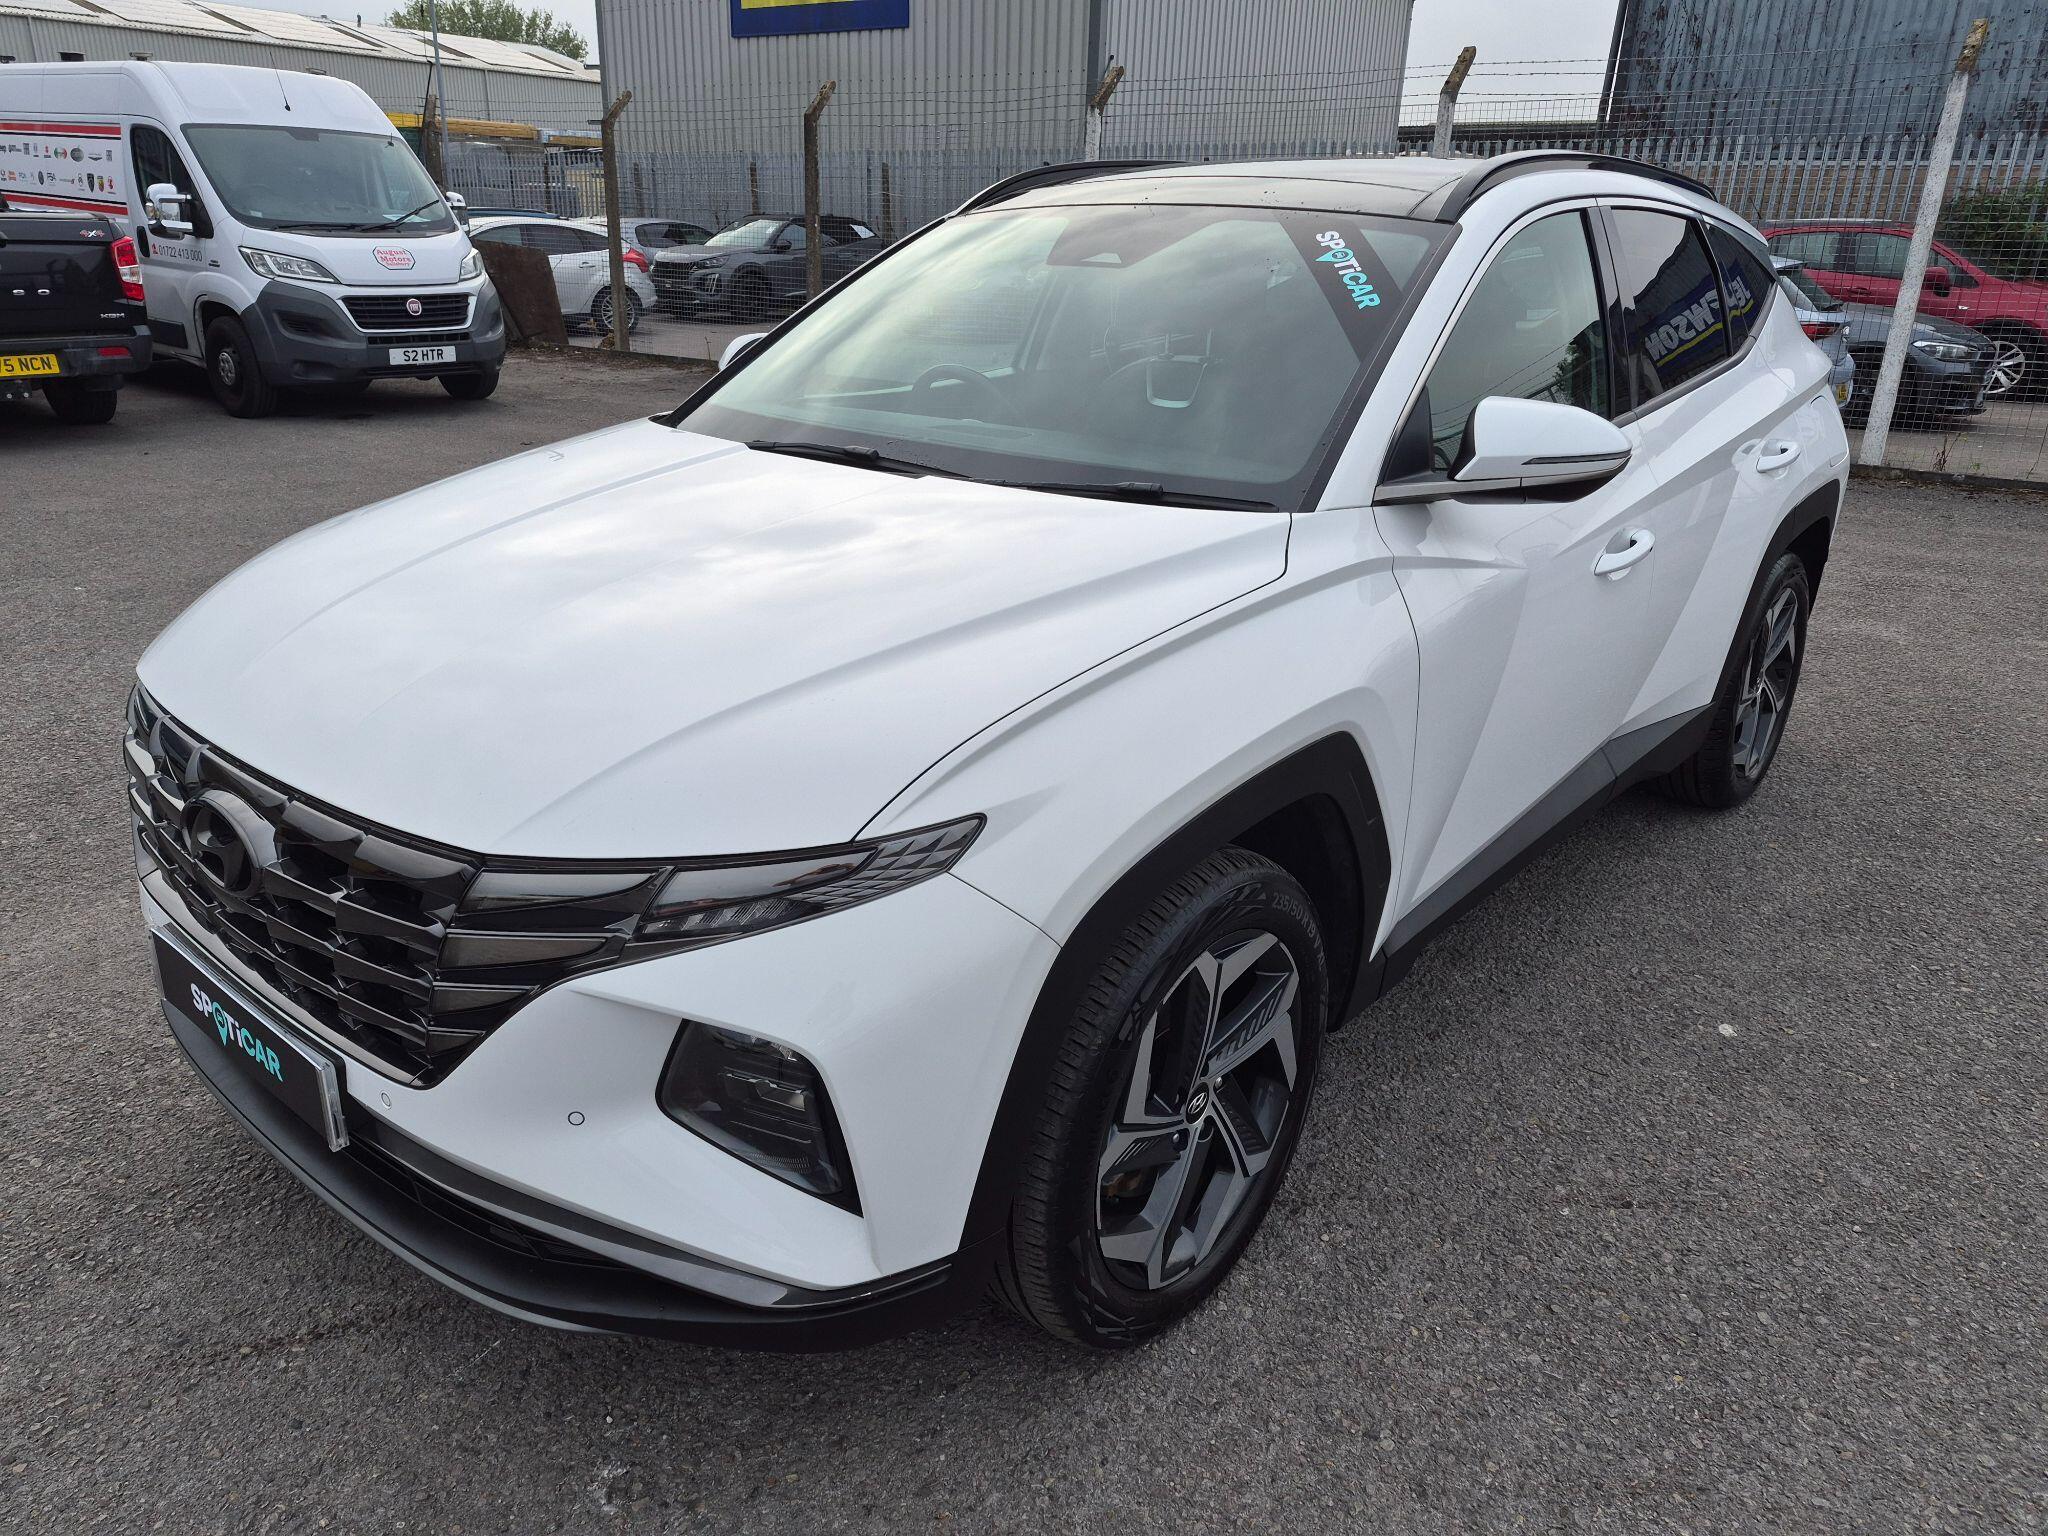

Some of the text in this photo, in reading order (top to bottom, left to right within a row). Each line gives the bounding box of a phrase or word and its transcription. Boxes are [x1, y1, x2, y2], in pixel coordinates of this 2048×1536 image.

[159, 245, 203, 262] 01722 413 000
[403, 348, 444, 362] S2 HTR
[18, 356, 52, 372] NCN
[1272, 892, 1304, 921] 235/50
